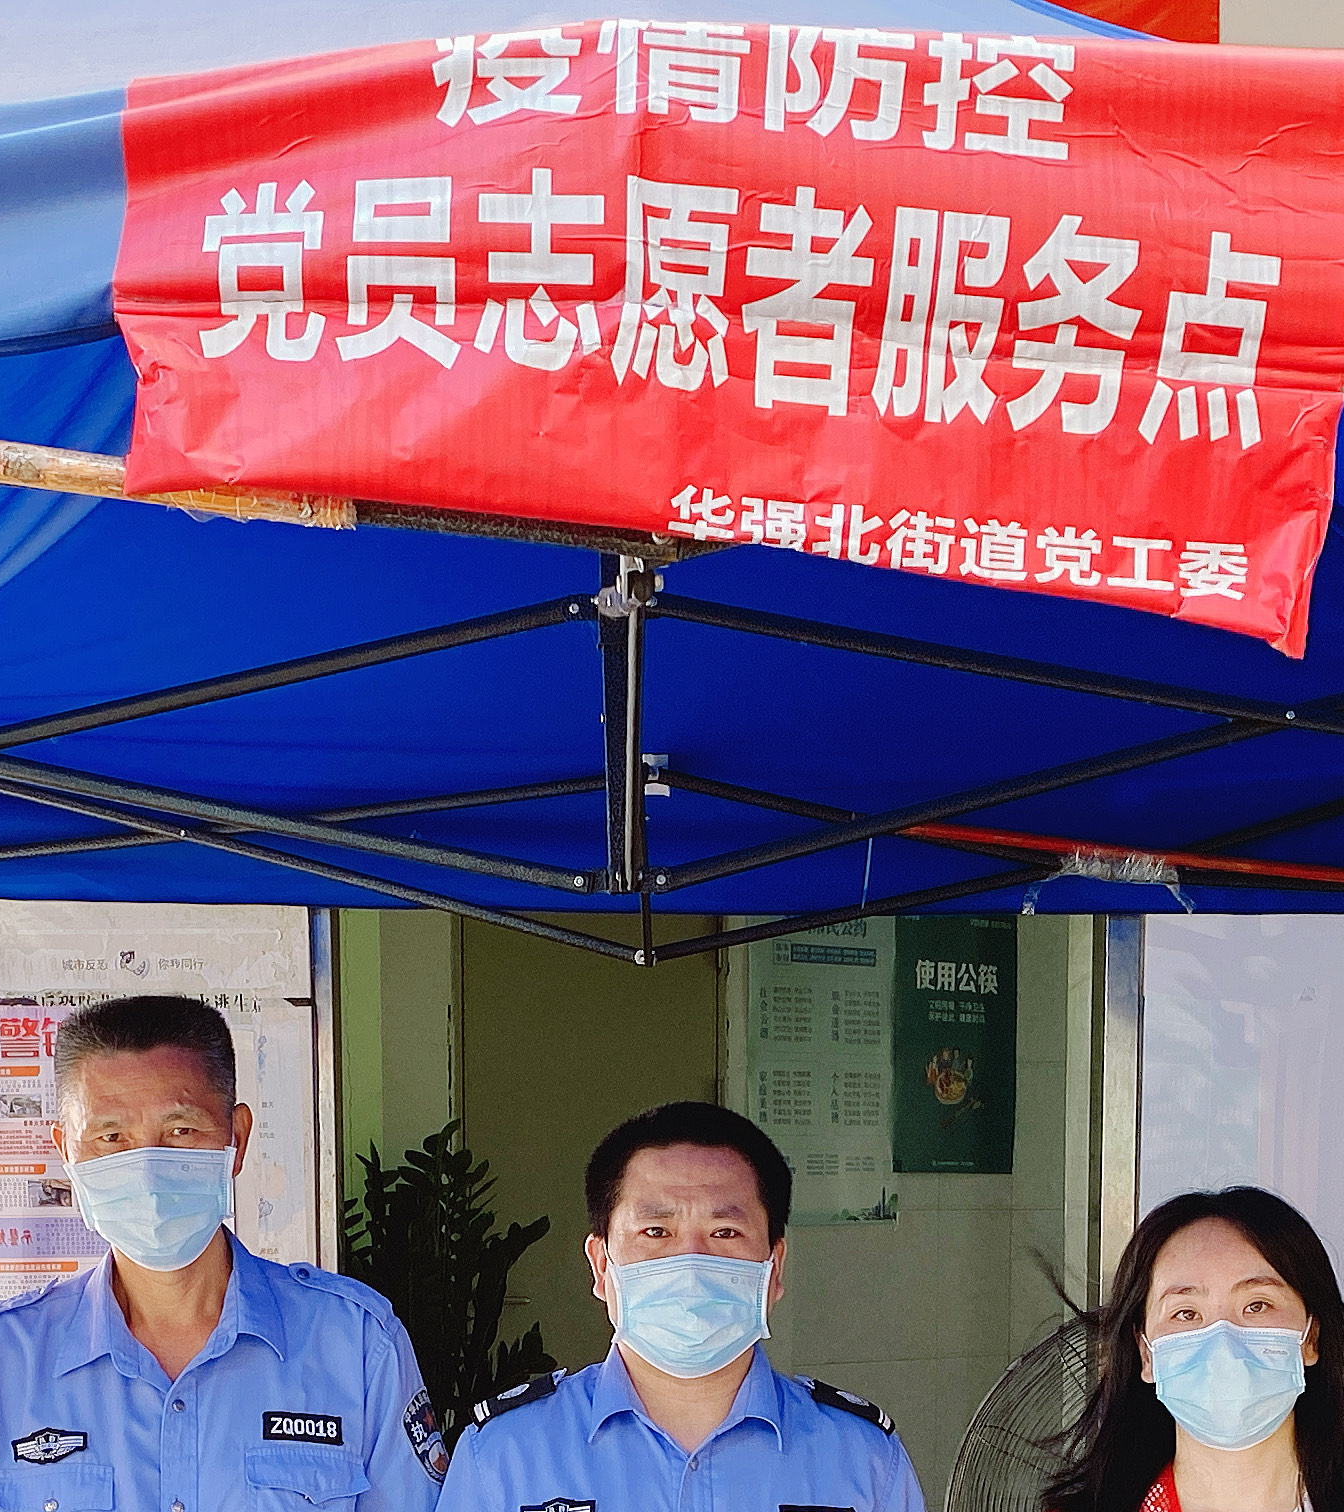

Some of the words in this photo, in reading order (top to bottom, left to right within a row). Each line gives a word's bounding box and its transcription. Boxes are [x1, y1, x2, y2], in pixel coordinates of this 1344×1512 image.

[433, 18, 1076, 161] 疫情防控
[201, 167, 1281, 451] 党员志愿者服务点
[668, 484, 1248, 602] 华强北街道党工委
[916, 959, 998, 994] 使用公筷
[270, 1416, 338, 1438] ZQ0018
